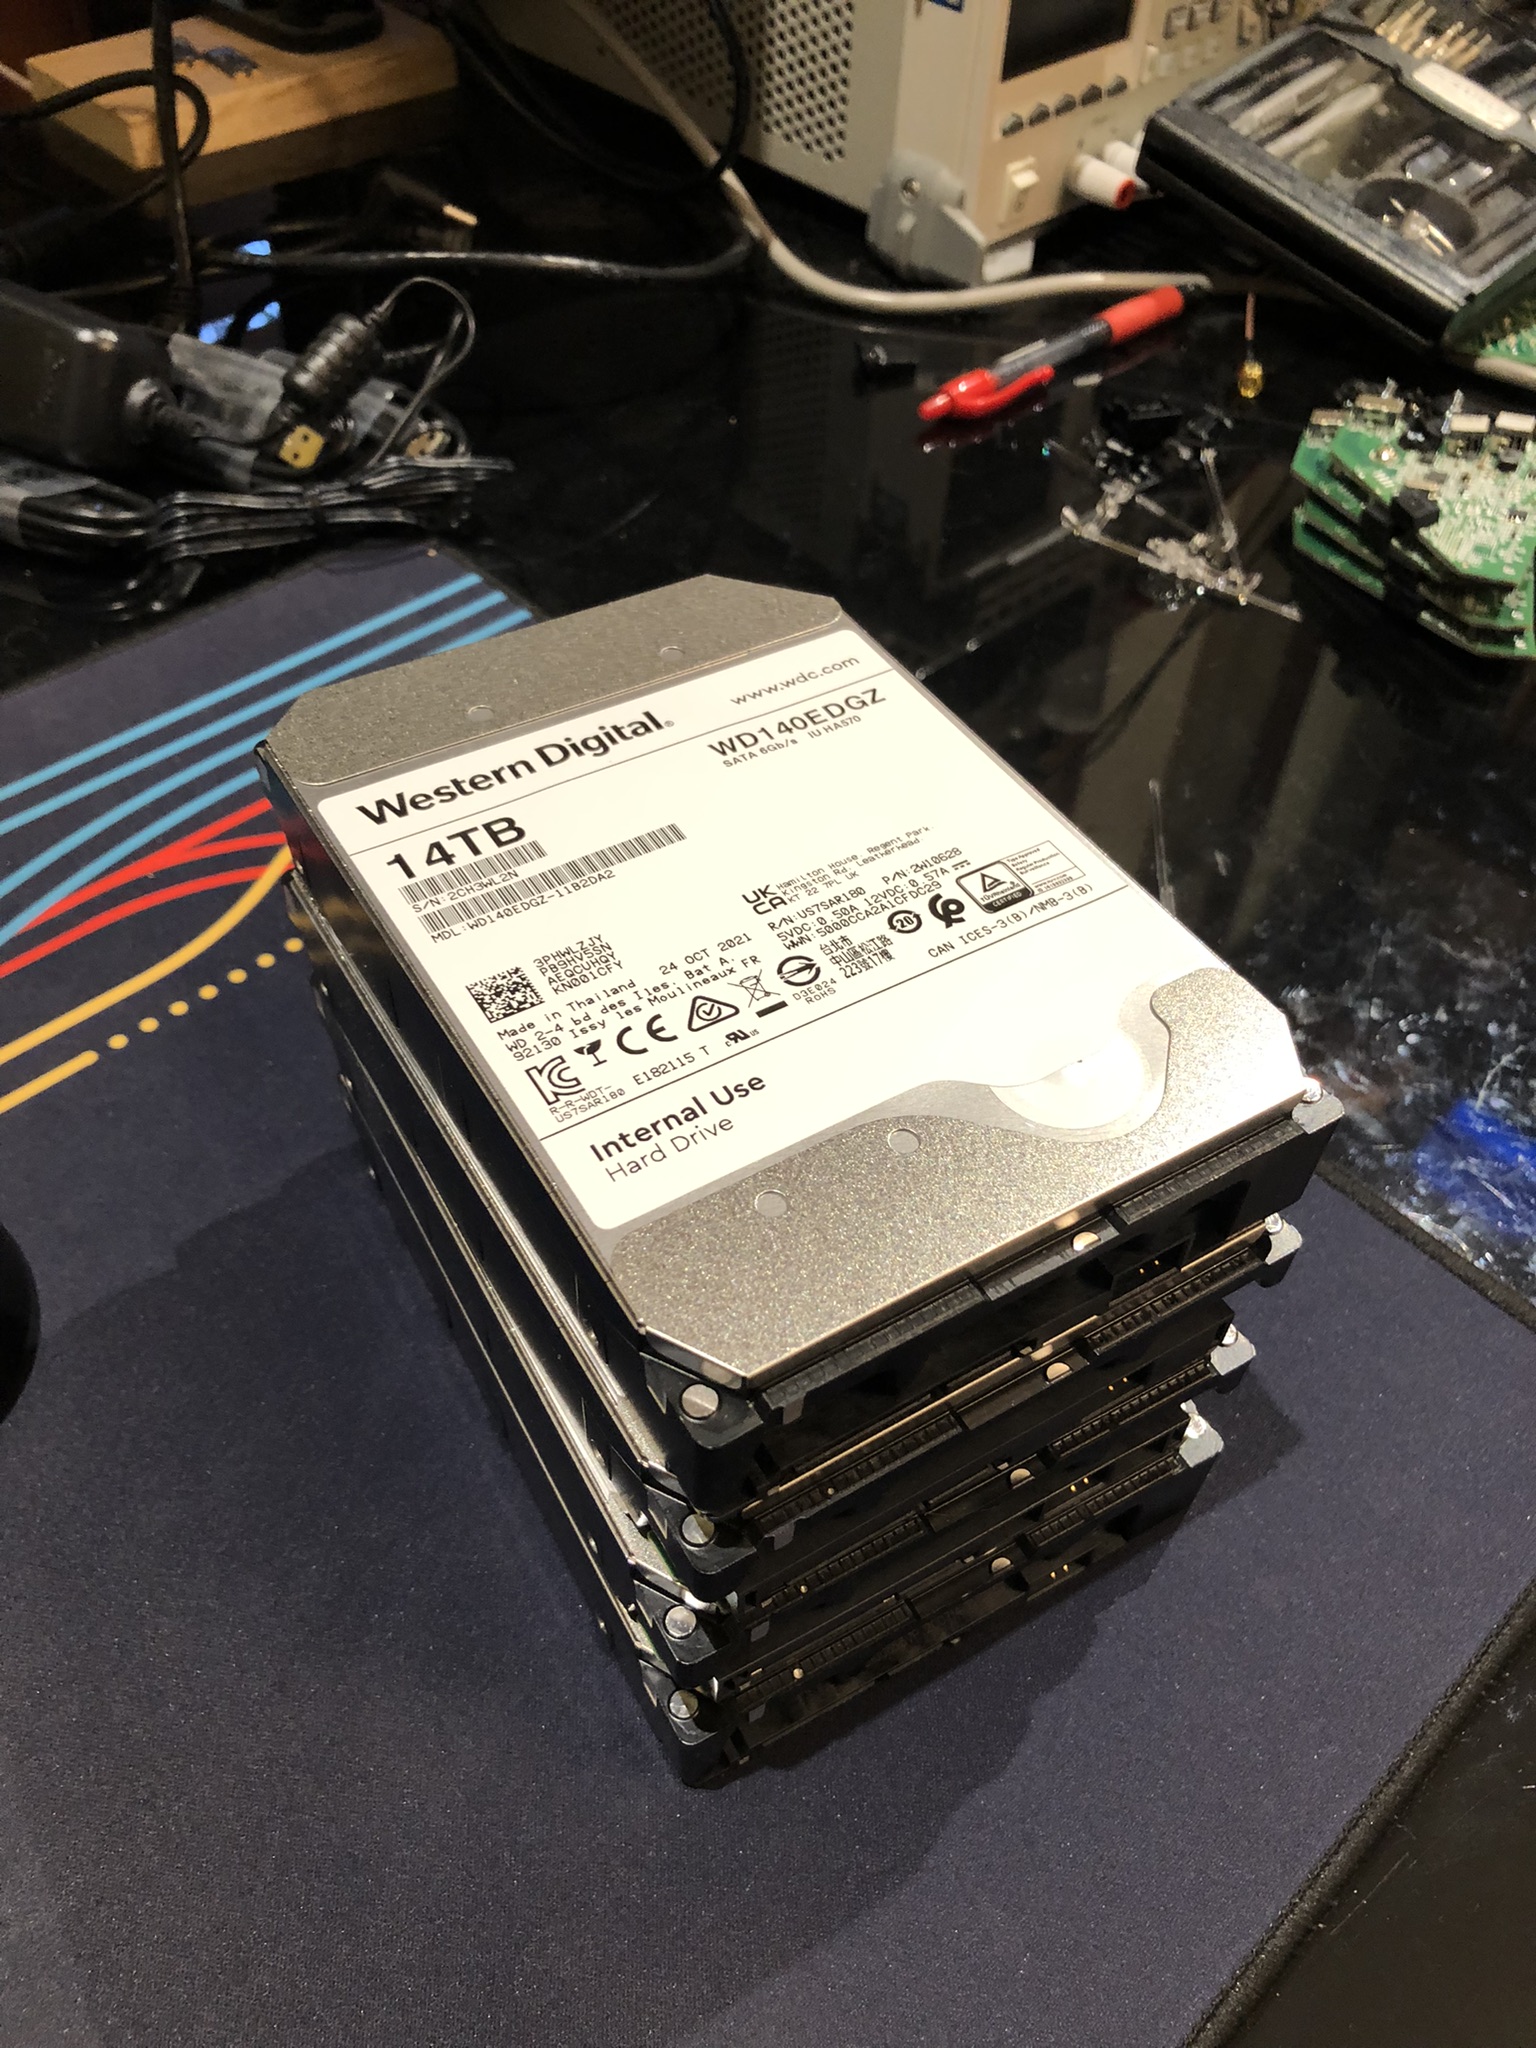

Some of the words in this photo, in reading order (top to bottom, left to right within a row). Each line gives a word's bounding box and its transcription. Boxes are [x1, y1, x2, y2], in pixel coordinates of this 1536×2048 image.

[730, 656, 860, 705] www.wdc.com
[707, 688, 886, 757] WD140EDGZ
[722, 751, 758, 768] SATA
[759, 738, 798, 756] 6Gb/s
[823, 715, 861, 735] HA570
[356, 759, 537, 826] Western
[386, 816, 526, 880] 14TB
[776, 867, 825, 890] Hamilton
[867, 836, 903, 854] Regent
[742, 884, 777, 904] UK
[781, 874, 831, 897] Kingston
[787, 893, 801, 903] KT
[805, 887, 819, 896] 22
[845, 870, 859, 880] UK
[896, 915, 914, 929] 20
[928, 941, 955, 958] CAN
[496, 1022, 535, 1040] Made
[544, 1011, 562, 1022] in
[566, 979, 636, 1012] Thailand
[659, 962, 678, 975] 24
[684, 948, 710, 964] OCT
[717, 933, 752, 952] 2021
[505, 1038, 527, 1052] WD
[534, 1023, 564, 1041] 2-4
[570, 1011, 591, 1025] bd
[600, 999, 626, 1014] des
[684, 963, 711, 980] Bat
[513, 1037, 561, 1061] 92130
[569, 1019, 606, 1039] Issy
[616, 1005, 642, 1020] les
[647, 967, 737, 1006] Moulineaux
[741, 955, 761, 968] FR
[633, 1052, 695, 1085] E182115
[699, 1045, 710, 1056] T
[590, 1096, 708, 1162] Internal
[710, 1076, 766, 1106] Use
[605, 1143, 667, 1182] Hard
[670, 1117, 734, 1153] Drive
